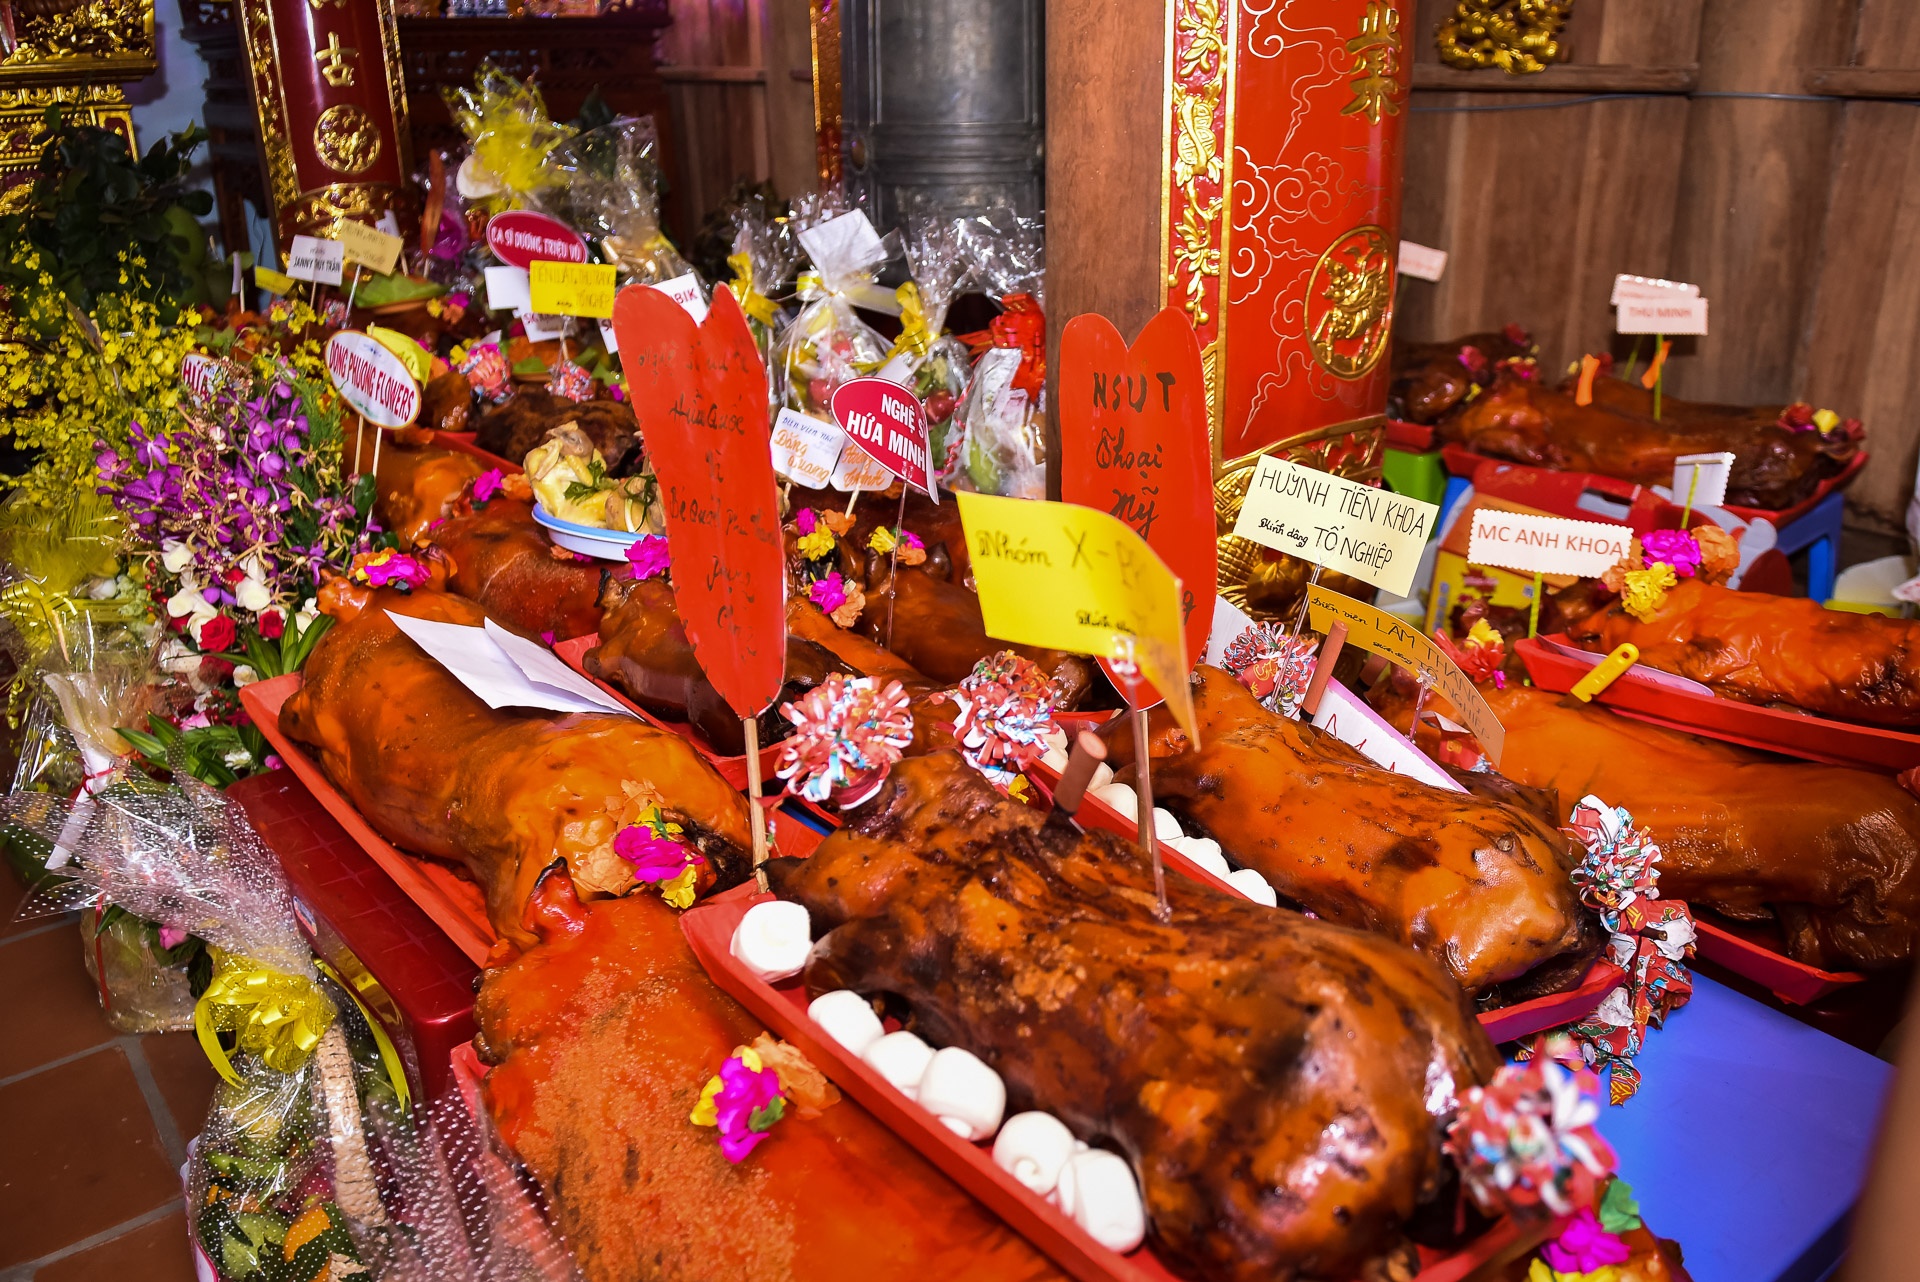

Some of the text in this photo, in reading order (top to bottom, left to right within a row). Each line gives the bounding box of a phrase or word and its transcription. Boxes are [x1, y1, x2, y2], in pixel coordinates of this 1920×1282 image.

[491, 226, 504, 244] CA
[375, 371, 414, 422] FLOWERS
[881, 394, 916, 434] NGHỆ
[846, 411, 884, 447] HỨA
[888, 430, 926, 473] MINH
[1259, 465, 1425, 538] HUỲNH TIẾN KHOA
[1286, 528, 1309, 549] dâng
[1313, 525, 1345, 552] TỔ
[1339, 536, 1394, 577] NGHIỆP
[1477, 523, 1624, 558] MC ANH KHOA
